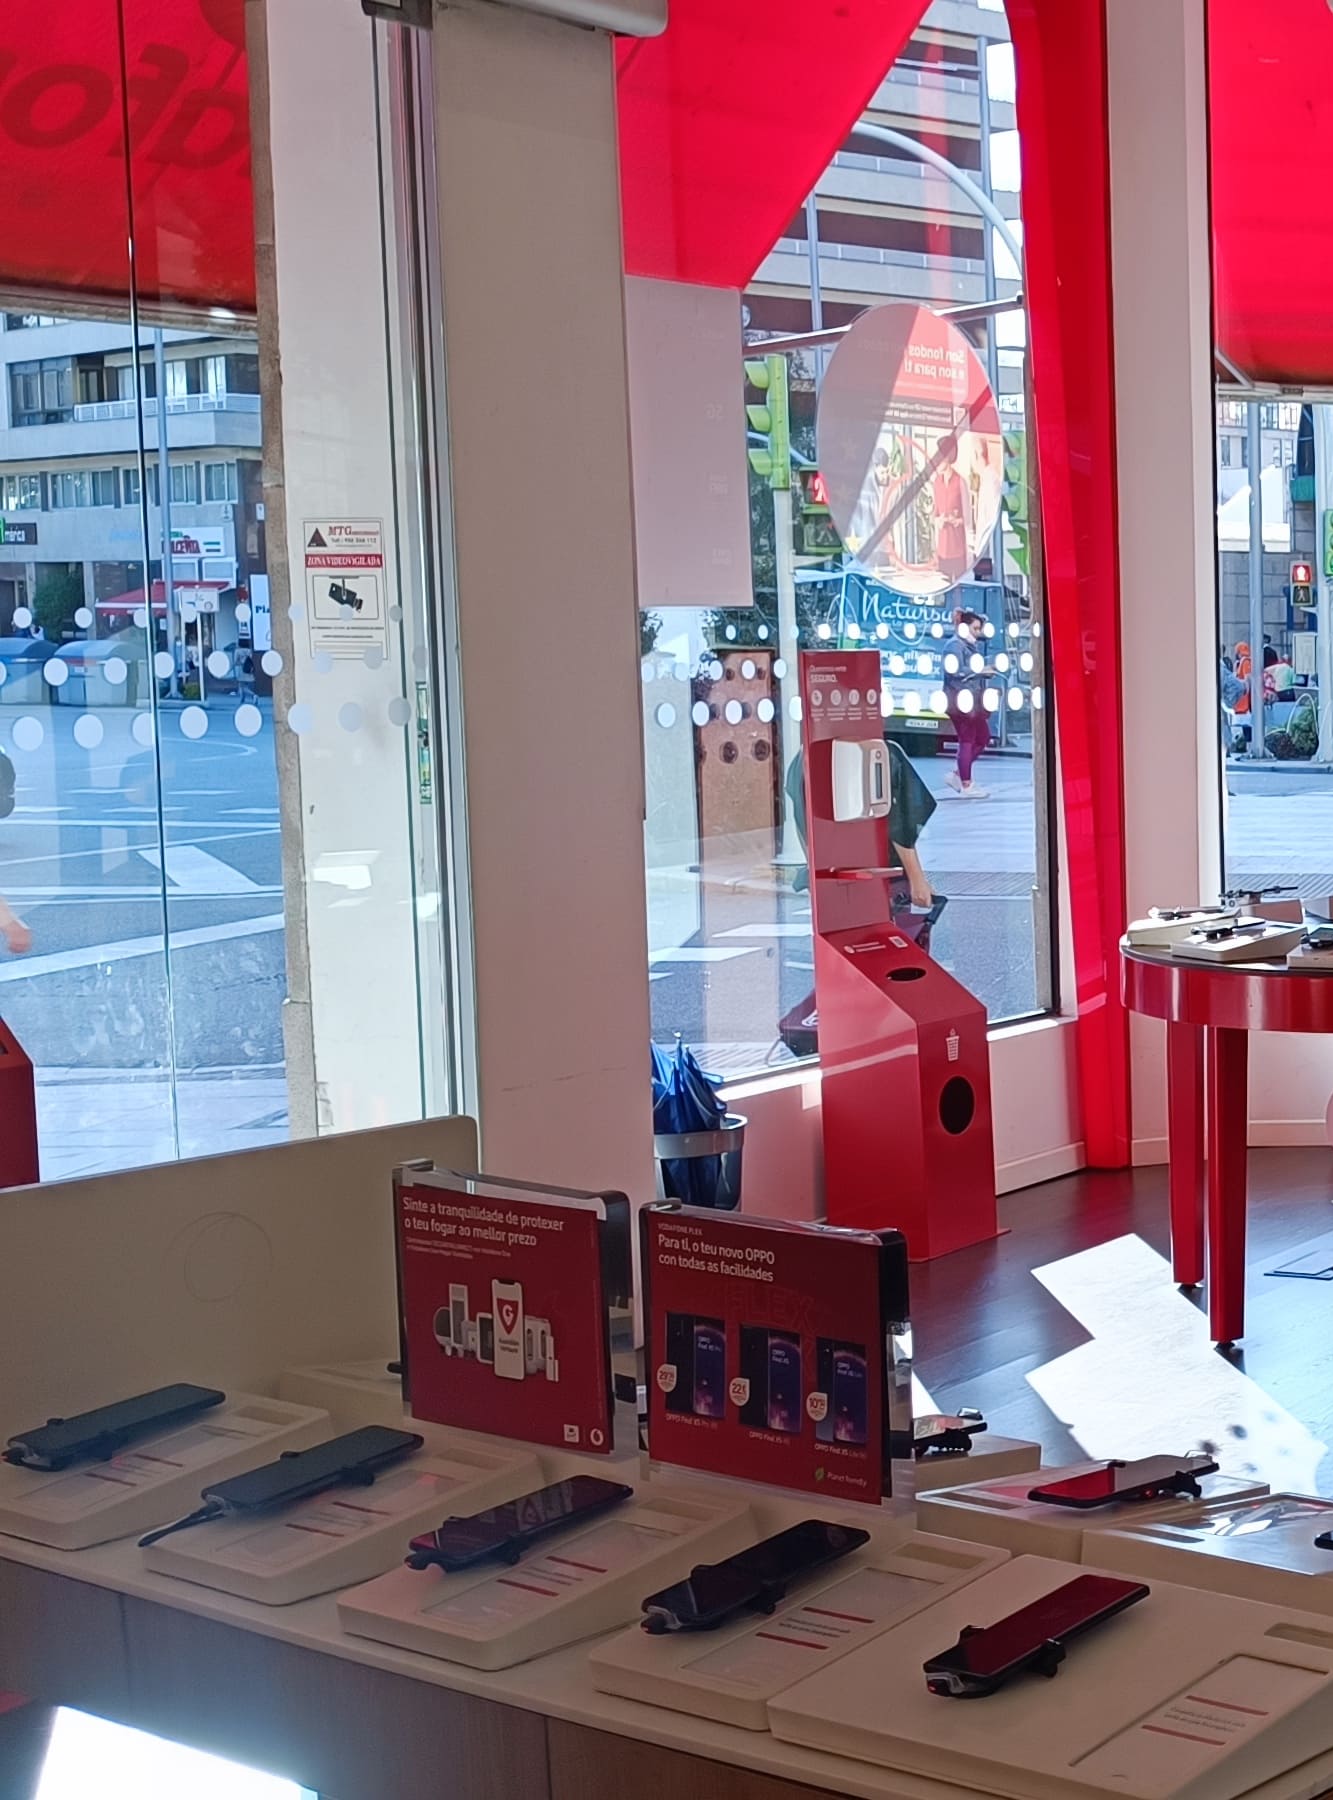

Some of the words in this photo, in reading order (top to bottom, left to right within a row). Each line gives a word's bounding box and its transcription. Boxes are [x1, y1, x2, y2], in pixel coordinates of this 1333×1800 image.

[403, 1196, 428, 1213] Sinte
[437, 1202, 504, 1224] tranquilidade
[505, 1211, 519, 1225] de
[520, 1214, 565, 1231] protexer
[413, 1217, 428, 1230] teu
[431, 1218, 457, 1237] fogar
[458, 1224, 471, 1237] ao
[473, 1226, 507, 1243] mellor
[508, 1233, 537, 1247] prezo
[658, 1234, 680, 1249] Para
[693, 1242, 700, 1252] o
[701, 1241, 718, 1256] teu
[719, 1246, 744, 1261] novo
[745, 1248, 775, 1265] OPPO
[658, 1252, 677, 1266] con
[678, 1255, 706, 1271] todas
[707, 1261, 719, 1274] as
[720, 1261, 774, 1283] facilidades
